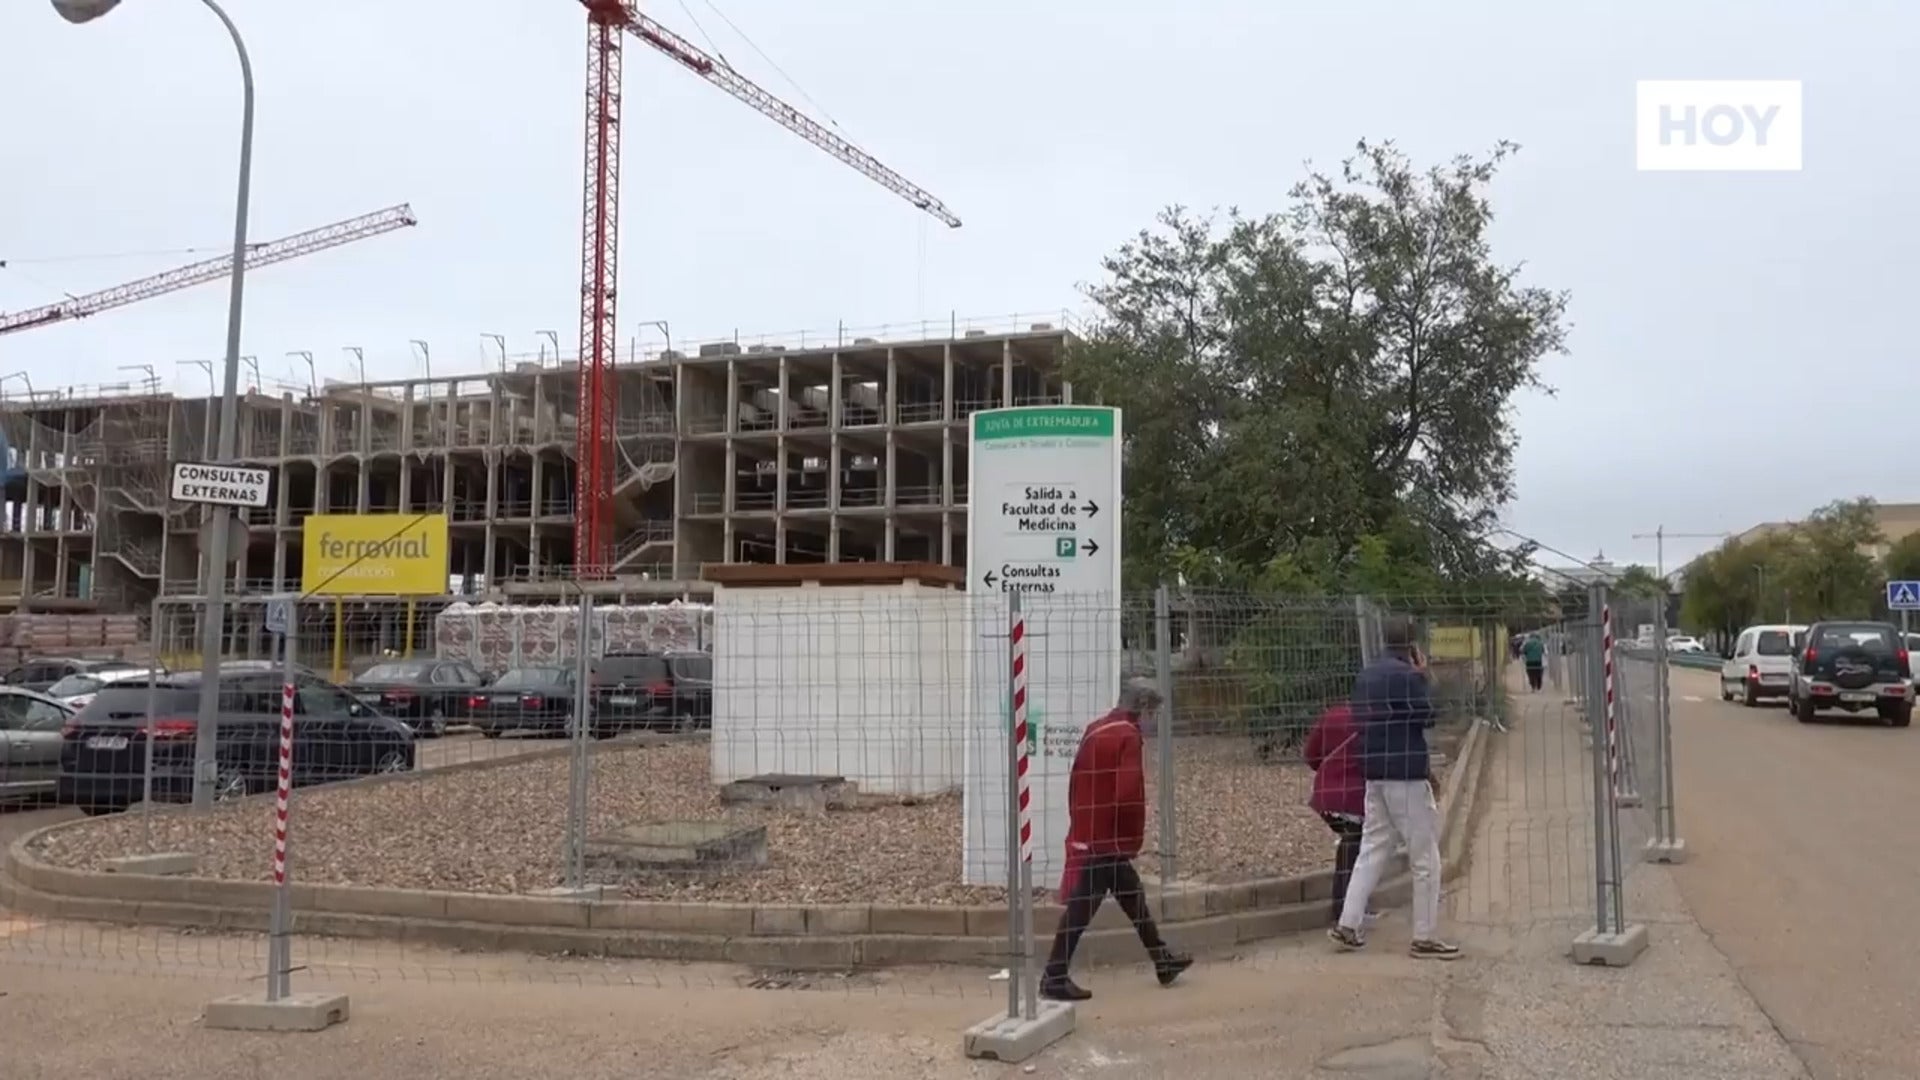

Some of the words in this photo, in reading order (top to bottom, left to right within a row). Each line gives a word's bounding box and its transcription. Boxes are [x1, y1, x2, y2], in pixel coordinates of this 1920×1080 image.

[985, 418, 1010, 432] JUNTA
[1013, 417, 1023, 429] DE
[1027, 416, 1099, 427] EXTREMADURA
[179, 466, 264, 485] CONSULTAS
[182, 484, 257, 502] EXTERNAS
[1025, 486, 1062, 500] Salida
[1069, 490, 1076, 500] a
[1002, 502, 1055, 515] Facultad
[1061, 502, 1076, 515] de
[1018, 518, 1076, 530] Medicina
[319, 531, 430, 559] ferrovial
[1002, 564, 1060, 577] Consultas
[1002, 580, 1055, 592] Externas
